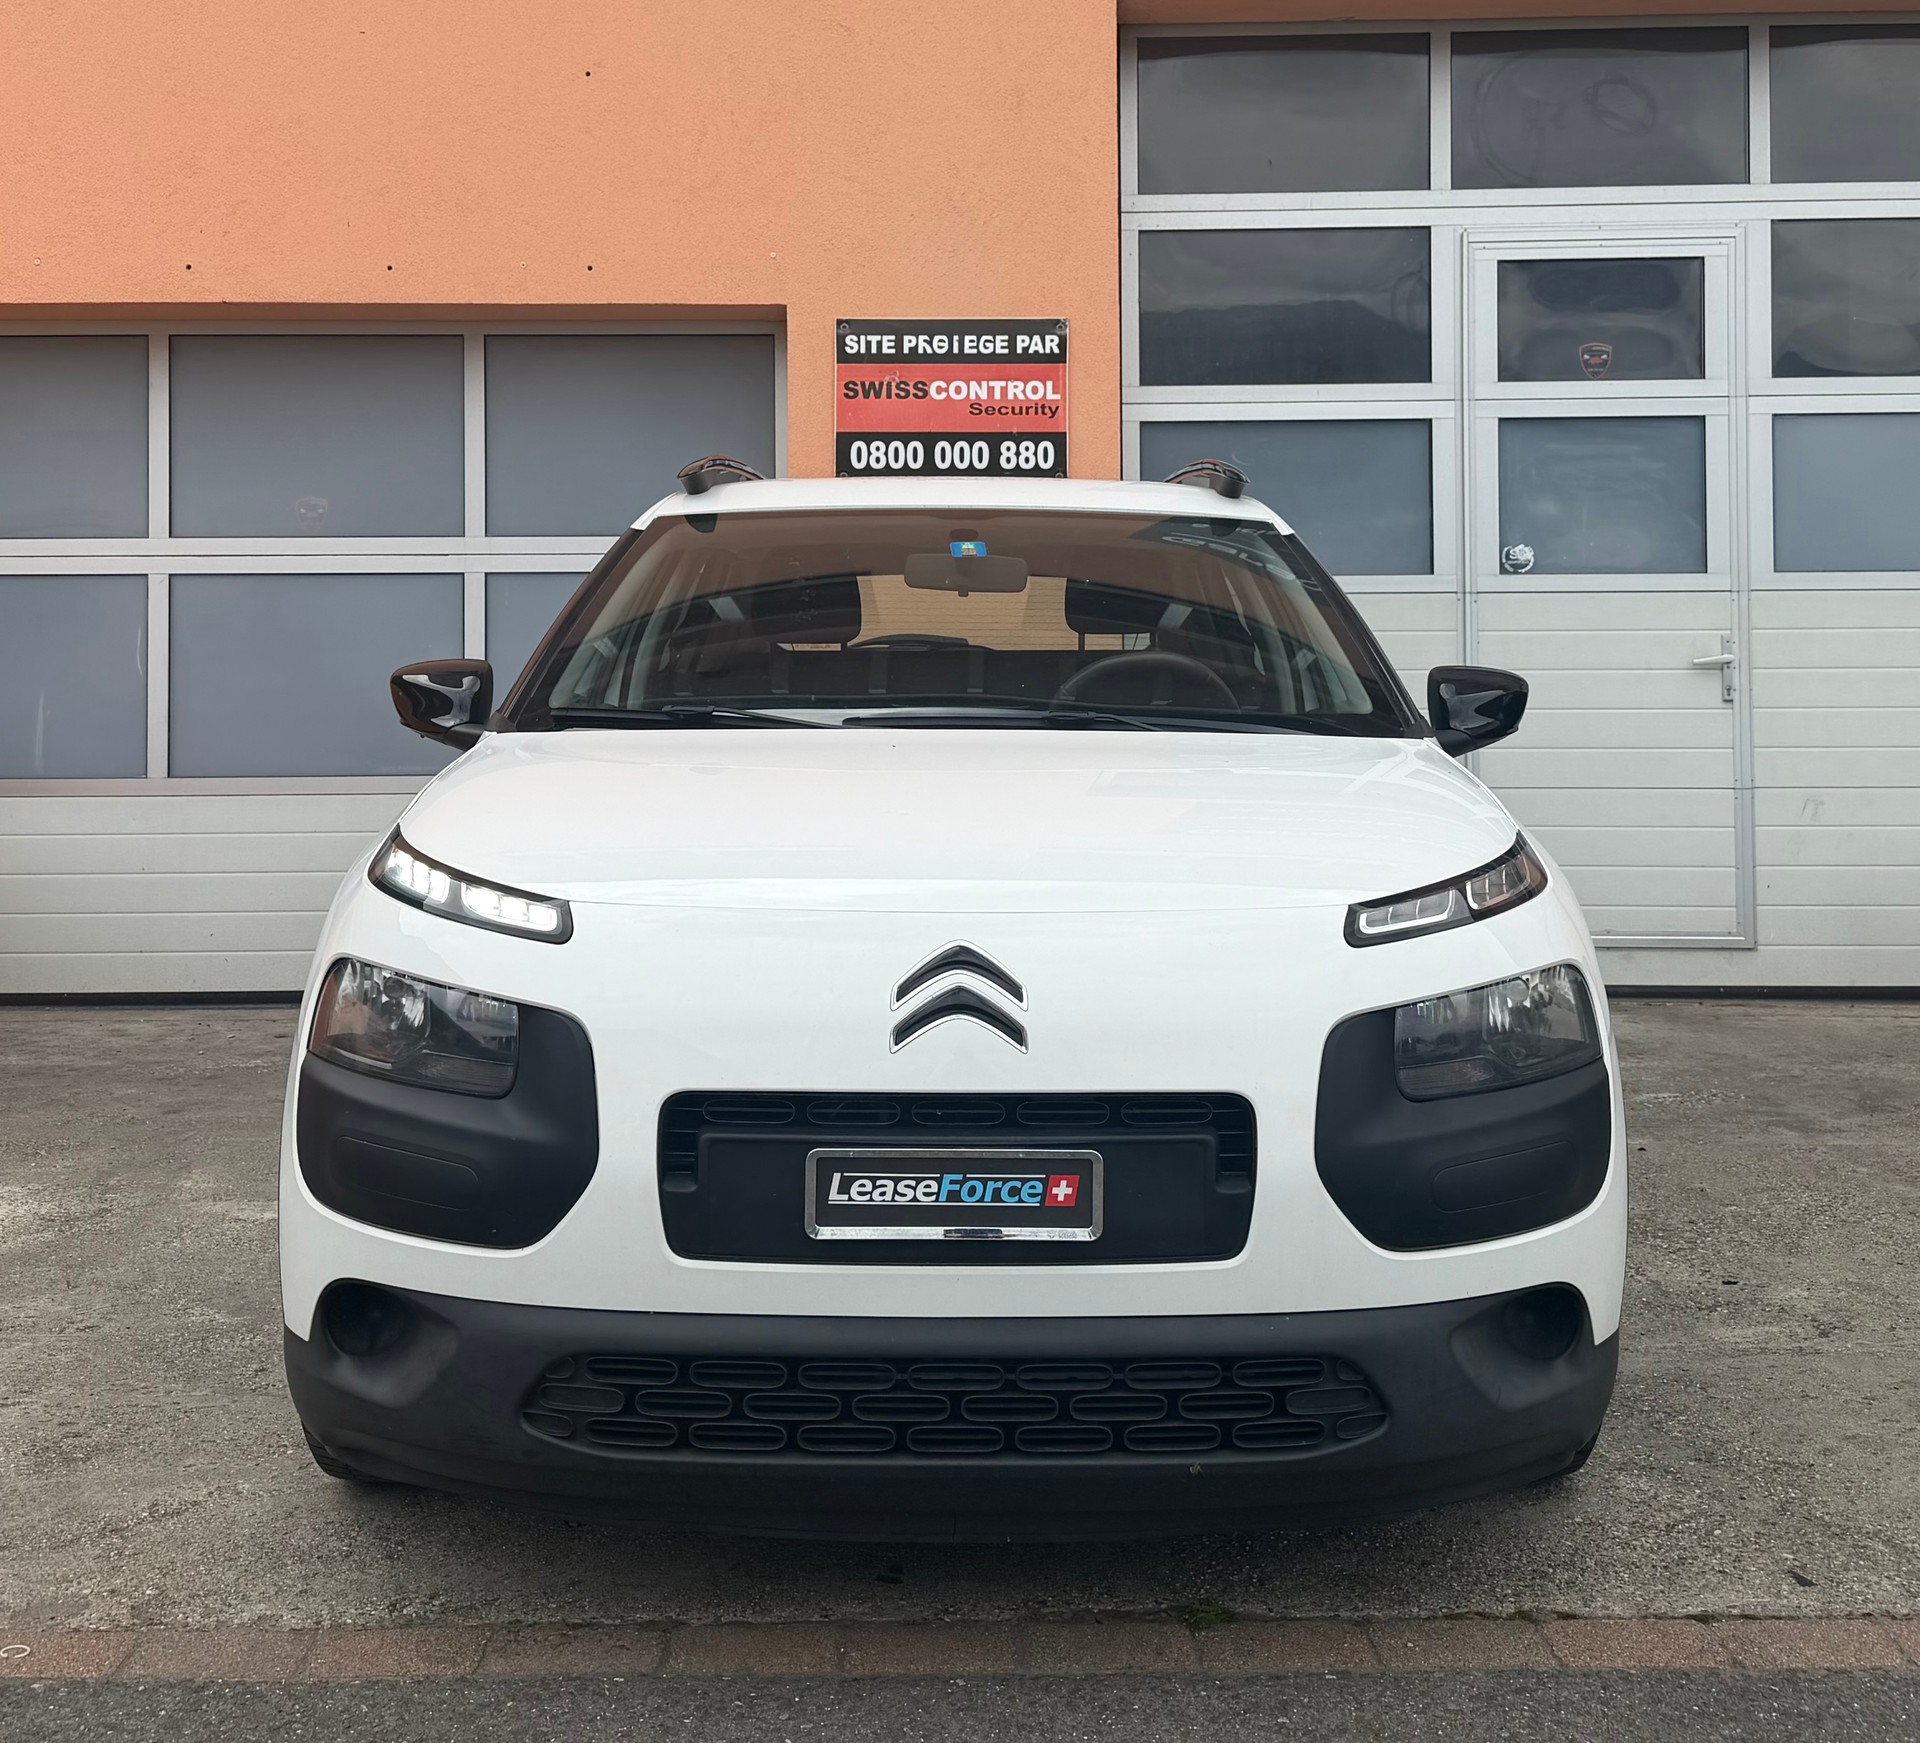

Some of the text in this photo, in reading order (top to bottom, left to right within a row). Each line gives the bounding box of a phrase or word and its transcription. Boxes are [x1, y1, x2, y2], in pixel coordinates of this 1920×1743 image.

[844, 334, 896, 354] SITE
[1016, 334, 1060, 354] PAR
[843, 379, 1061, 400] SWISSCONTROL
[969, 402, 1059, 419] Security
[850, 440, 1055, 470] 0800 000 880
[828, 1172, 1042, 1203] LeaseForce
